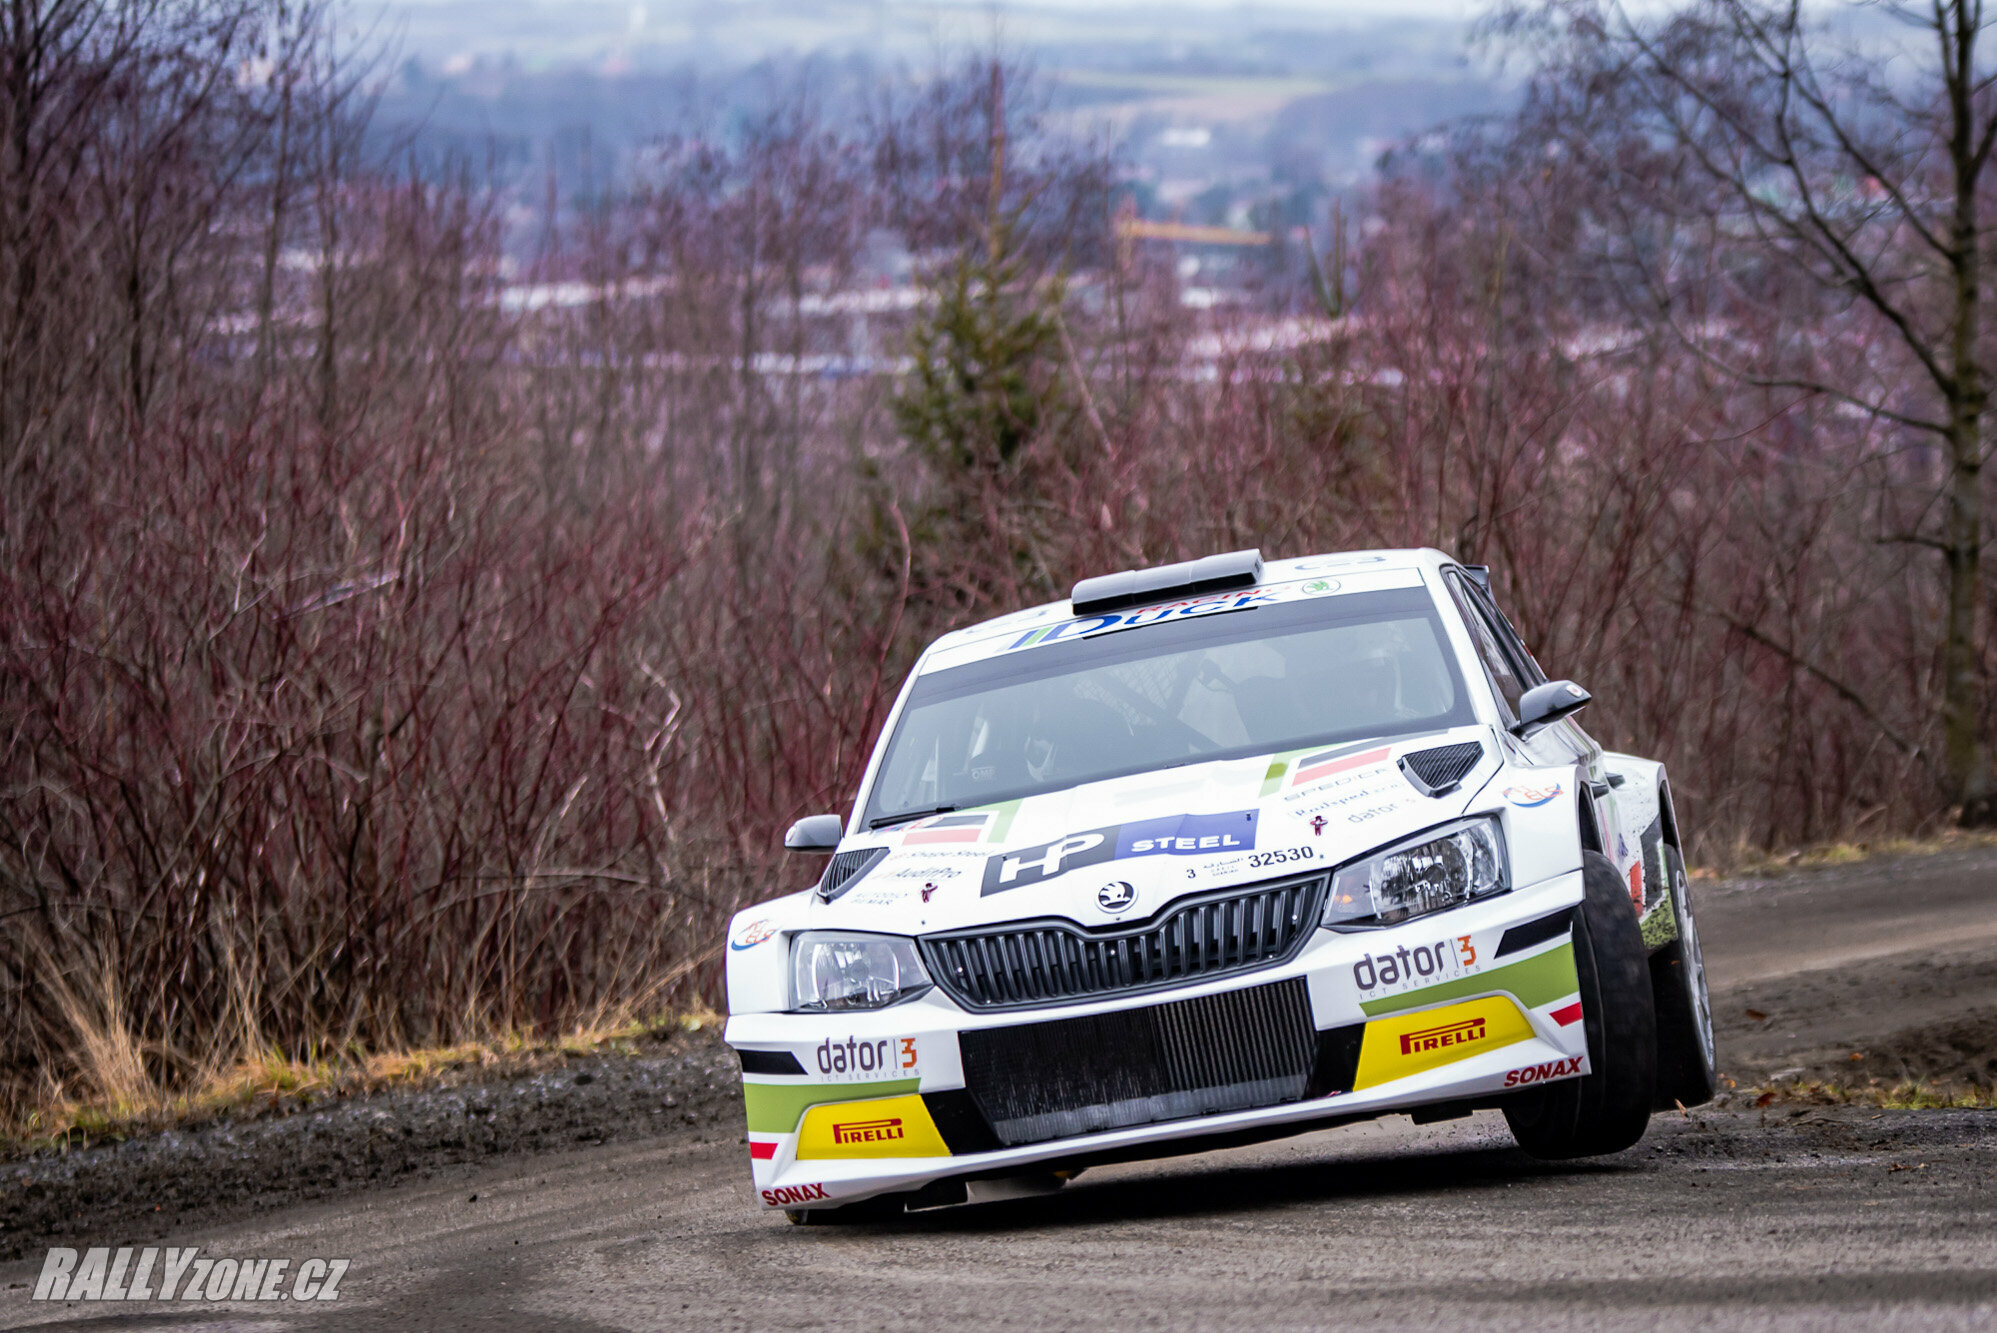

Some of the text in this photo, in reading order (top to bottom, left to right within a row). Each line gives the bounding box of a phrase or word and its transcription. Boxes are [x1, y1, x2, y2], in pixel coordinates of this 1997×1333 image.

[999, 833, 1241, 884] HP STEEL
[1248, 846, 1315, 868] 32530
[1186, 868, 1197, 879] 3
[1353, 935, 1477, 991] dator 3
[1360, 965, 1481, 1000] ICT SERVICES
[1400, 1017, 1486, 1056] PIRELLI
[817, 1035, 918, 1074] dator 3
[848, 1068, 920, 1081] SERVICES
[1504, 1056, 1584, 1087] SONAX
[832, 1118, 904, 1144] PIRELLI
[761, 1183, 831, 1206] SONAX
